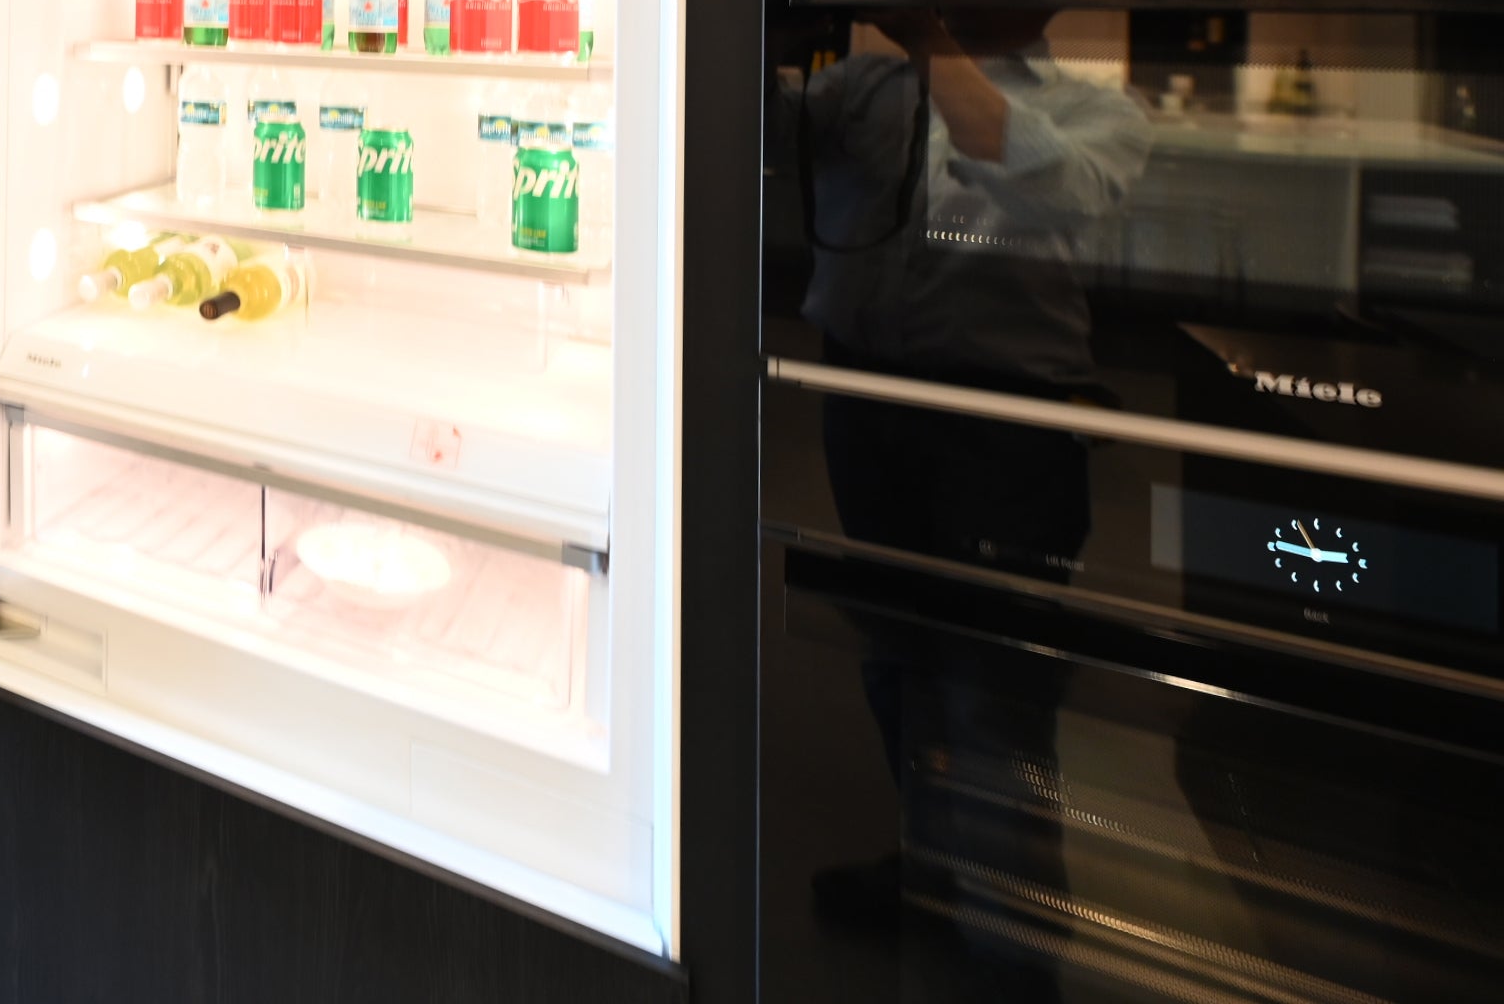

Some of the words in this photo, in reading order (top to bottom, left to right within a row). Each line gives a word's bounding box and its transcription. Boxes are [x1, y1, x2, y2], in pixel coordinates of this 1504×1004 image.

[357, 139, 414, 178] prit
[512, 158, 579, 201] prit
[1254, 370, 1383, 408] Miele
